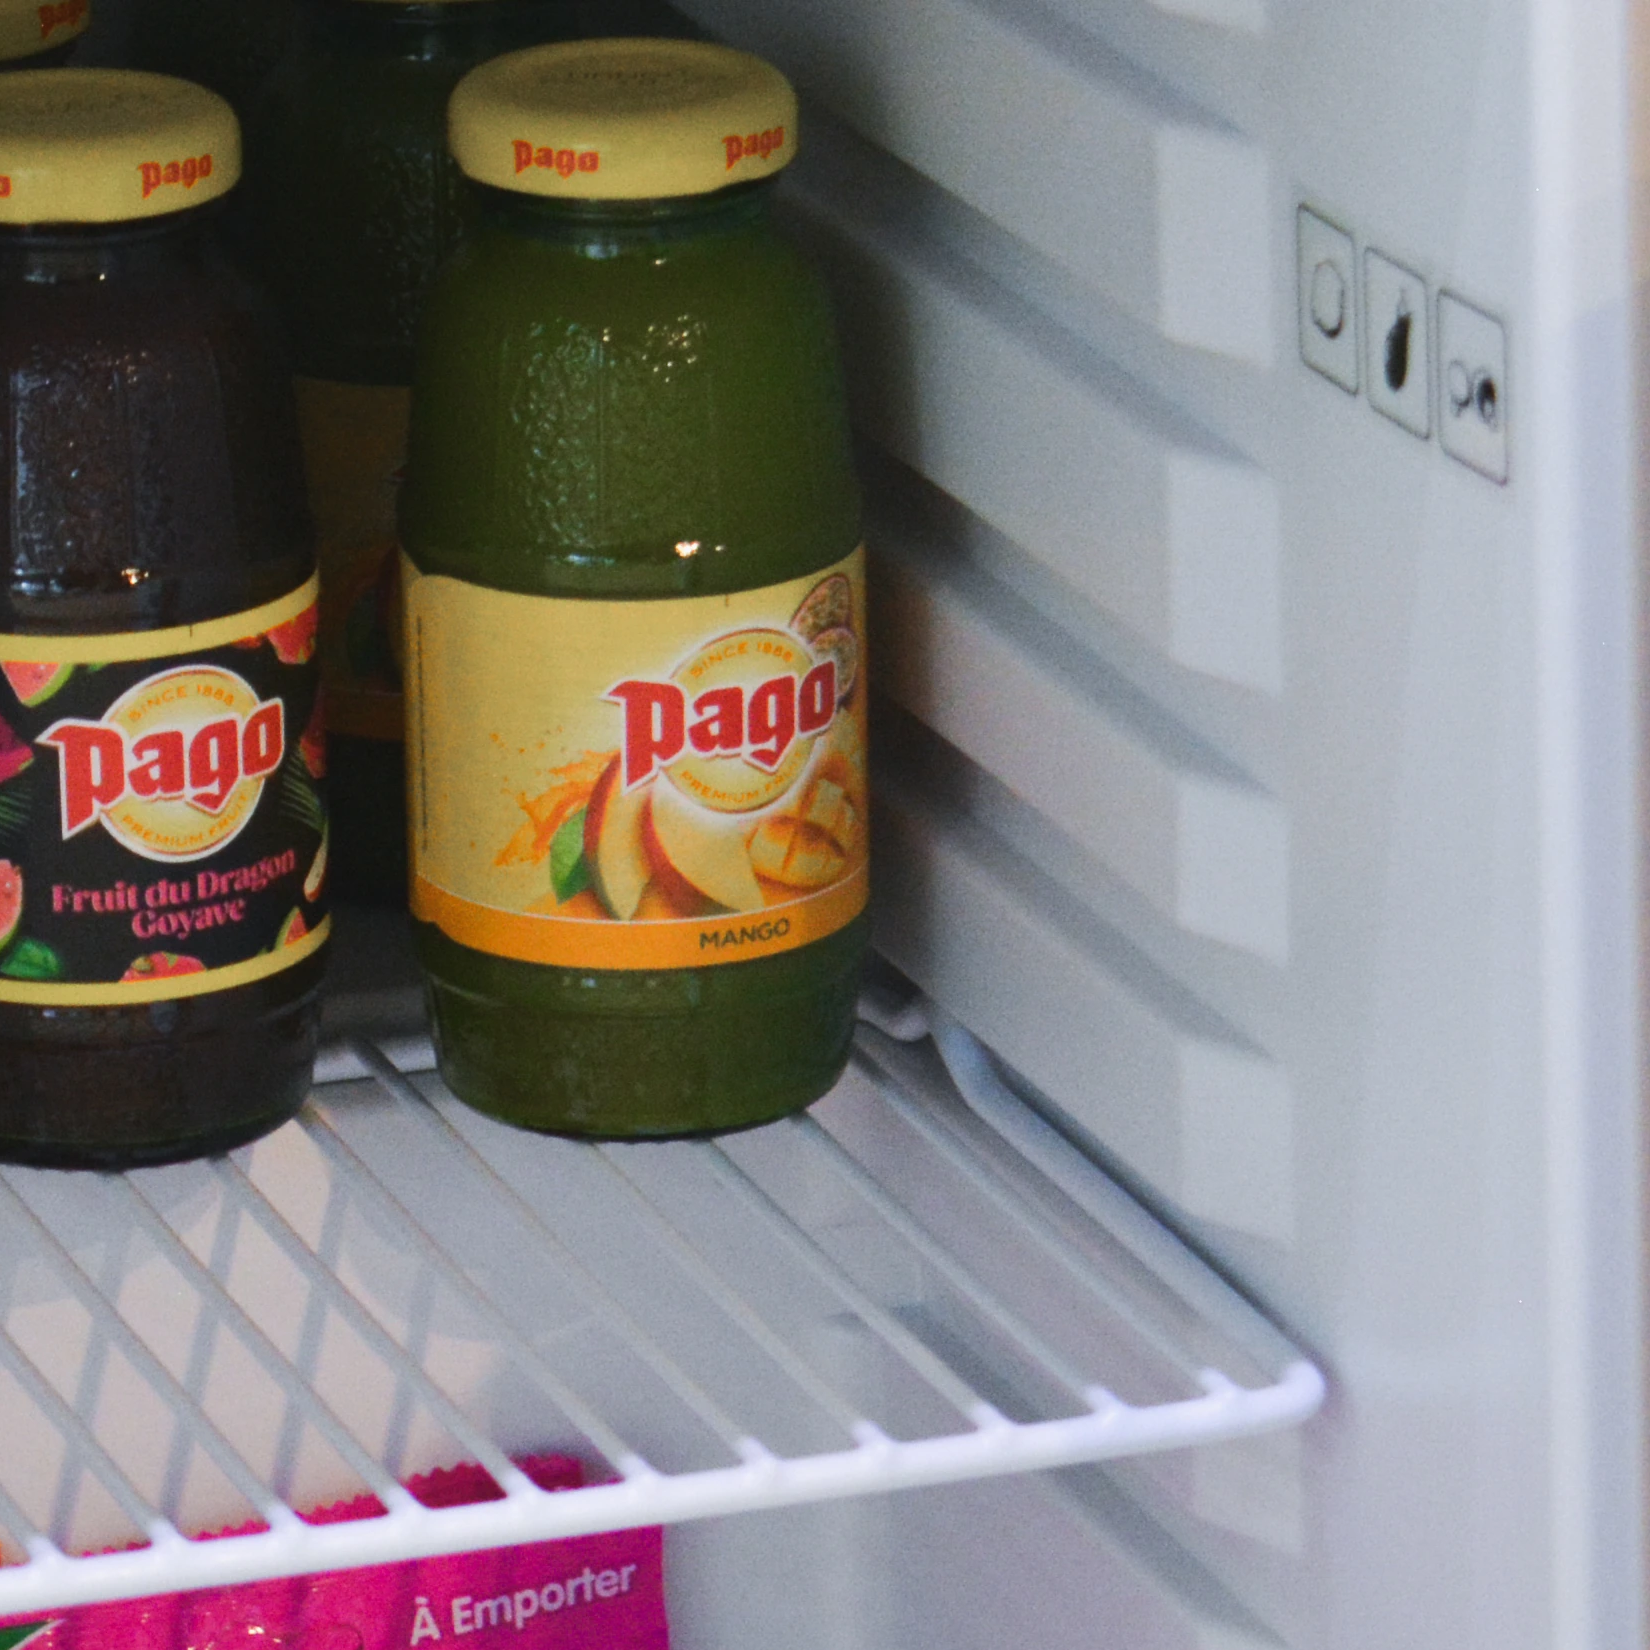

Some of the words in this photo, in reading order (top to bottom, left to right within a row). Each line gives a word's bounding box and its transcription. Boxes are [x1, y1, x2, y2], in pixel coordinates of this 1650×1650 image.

[511, 138, 600, 180] pago
[721, 125, 785, 171] pago
[136, 153, 214, 200] pago
[604, 658, 838, 792] pago
[40, 699, 285, 837] pago
[52, 880, 138, 913] Fruit
[144, 877, 191, 908] du
[197, 848, 296, 900] Dragon
[131, 896, 246, 940] Goyave
[698, 916, 792, 952] MANGO
[410, 1597, 442, 1646] À
[451, 1561, 638, 1633] Emporter
